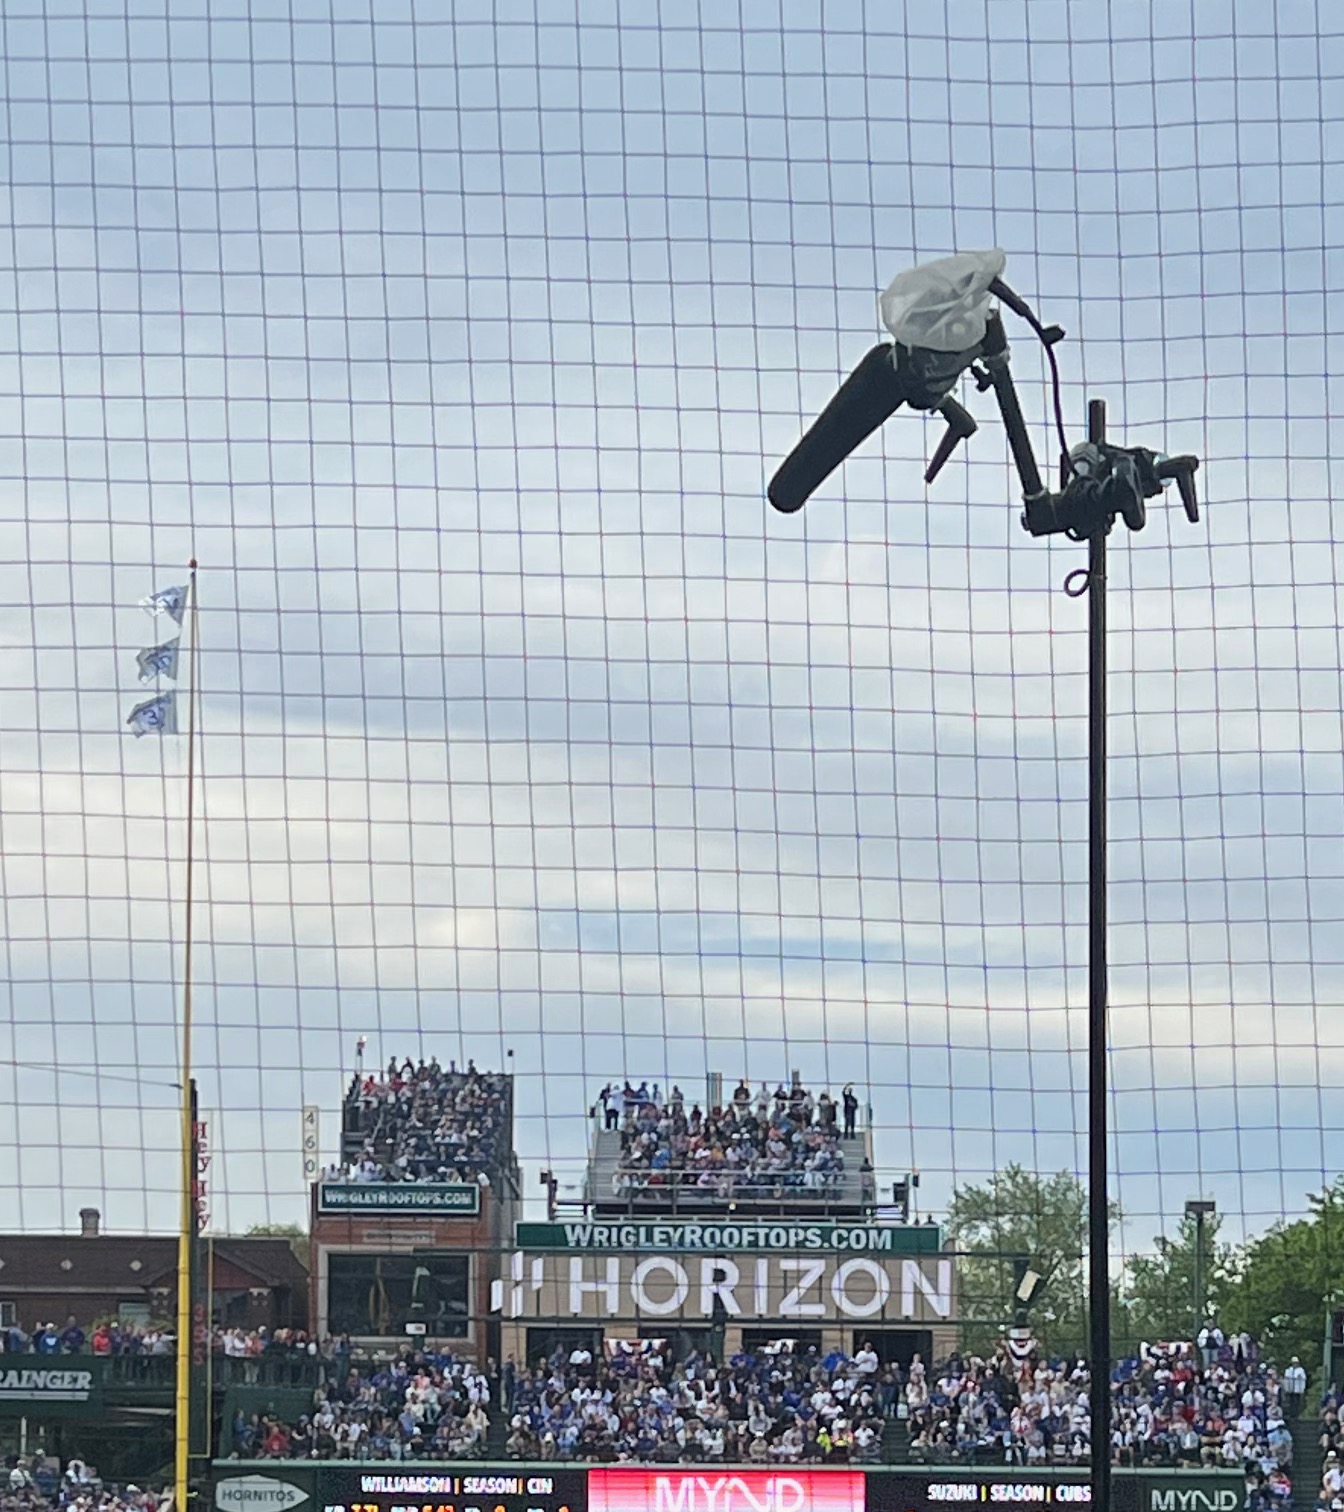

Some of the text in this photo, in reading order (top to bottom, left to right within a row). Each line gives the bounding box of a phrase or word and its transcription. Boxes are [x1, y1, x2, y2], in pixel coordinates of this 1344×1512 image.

[564, 1222, 892, 1251] WRIGLEYROOFTOPS.COM
[568, 1255, 953, 1318] HORIZON
[360, 1475, 452, 1494] WILLIAMSON
[463, 1475, 518, 1494] SEASON
[927, 1484, 1092, 1502] SUZUKI SEASON CUBS
[221, 1489, 297, 1502] HORNITOS
[1151, 1489, 1238, 1512] MYND
